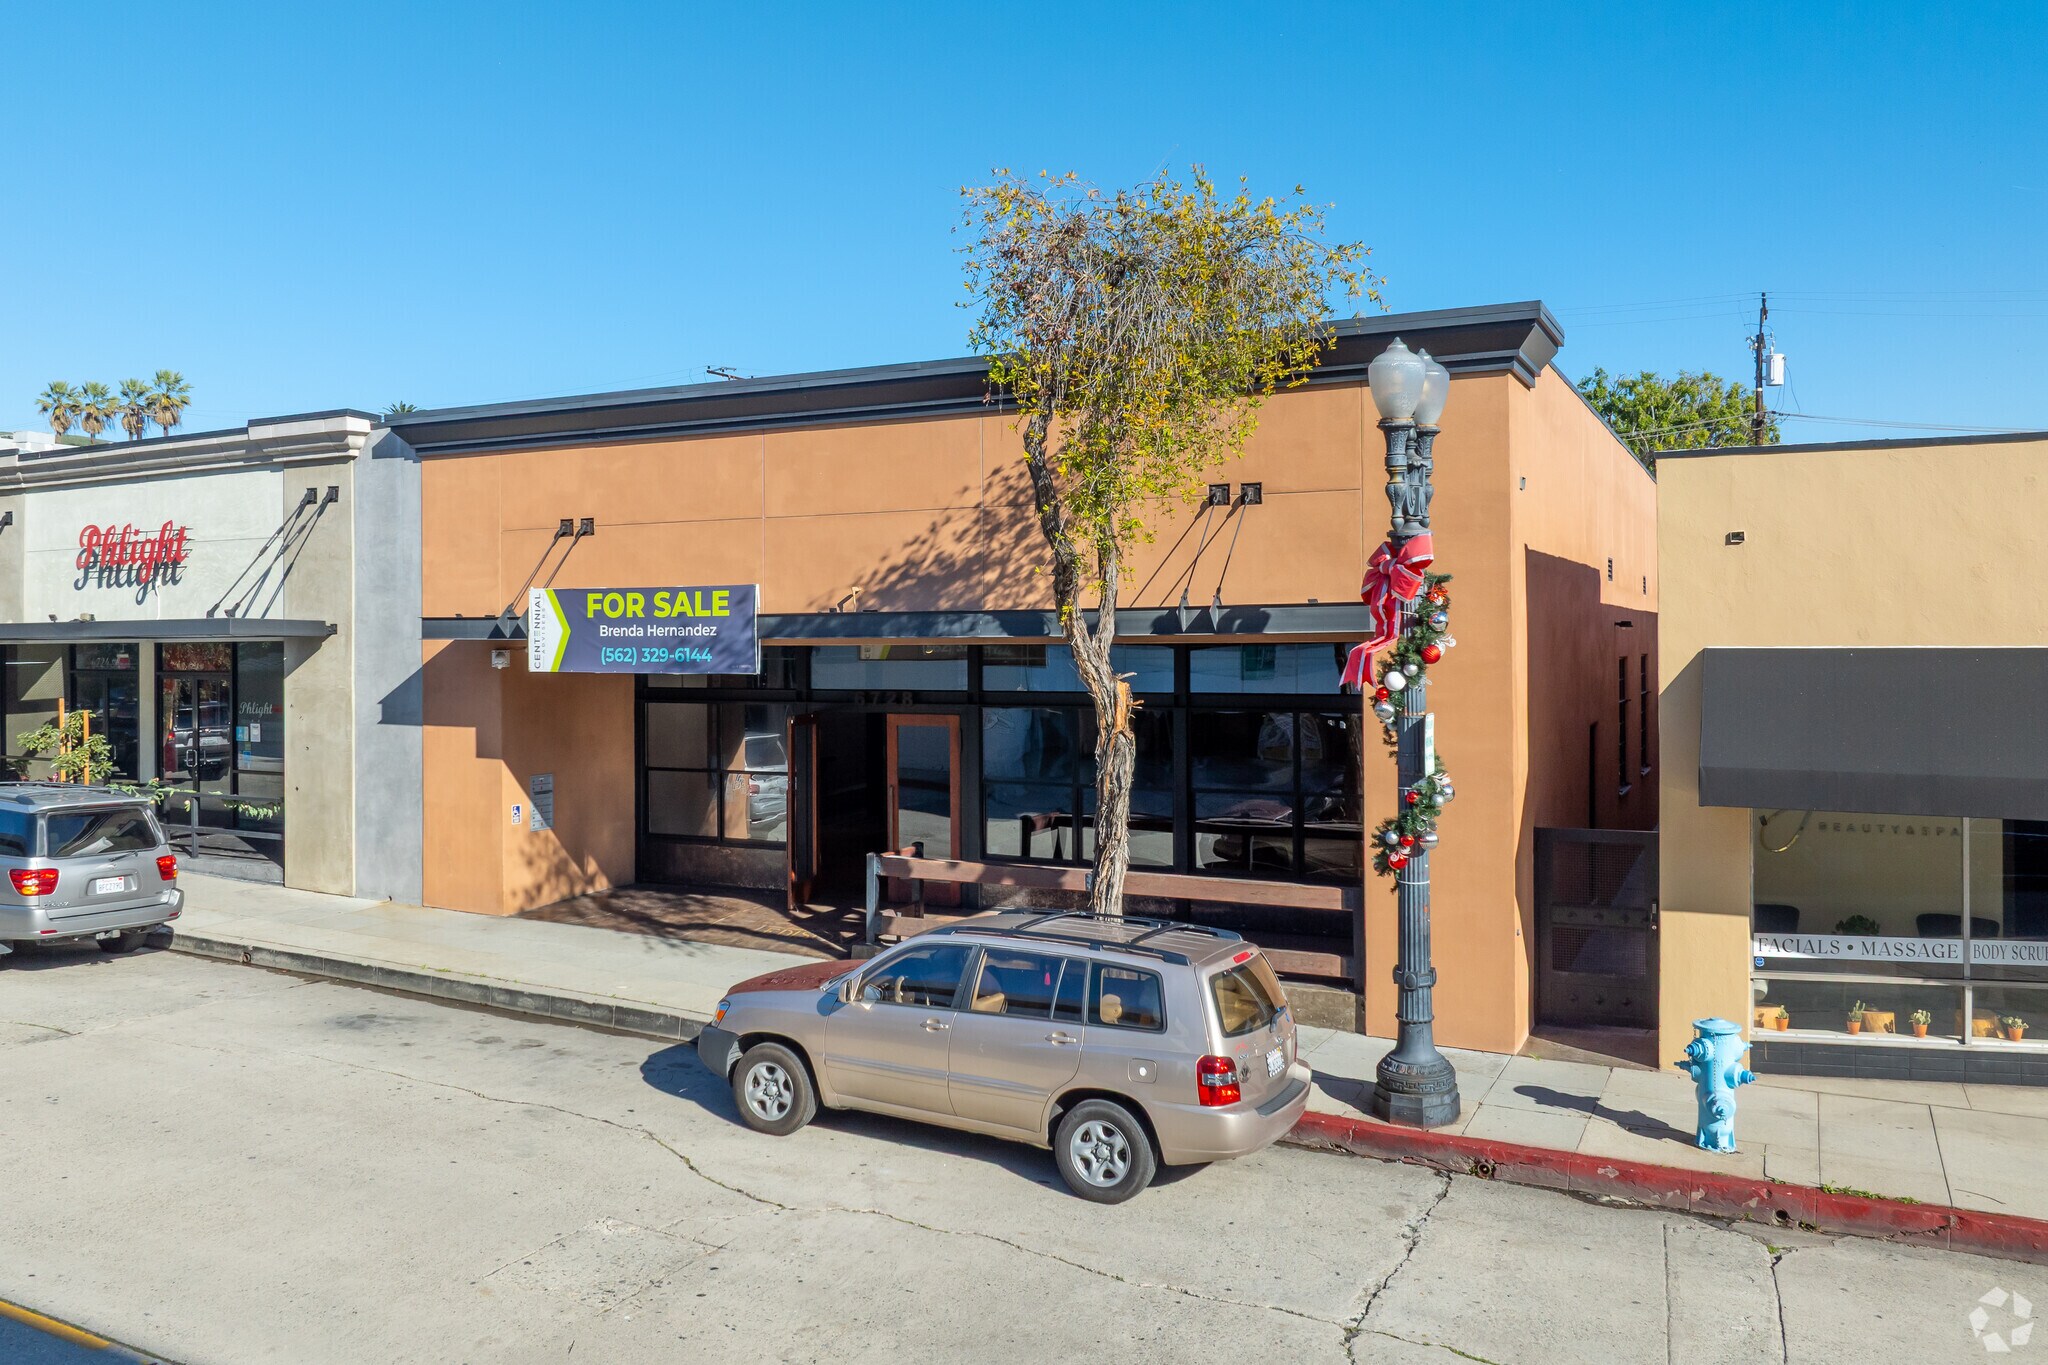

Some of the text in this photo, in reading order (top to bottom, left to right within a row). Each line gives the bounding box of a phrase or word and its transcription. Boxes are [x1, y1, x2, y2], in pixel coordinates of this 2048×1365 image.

[76, 520, 189, 583] Phlight
[587, 590, 730, 618] FOR SALE
[600, 623, 717, 637] Brenda Hernandez
[601, 647, 712, 665] (562) 329-6144
[855, 691, 913, 706] 6728
[239, 702, 272, 717] Phlight
[1758, 937, 1959, 959] FACIALS MASSAGE
[1973, 944, 2008, 960] BODY
